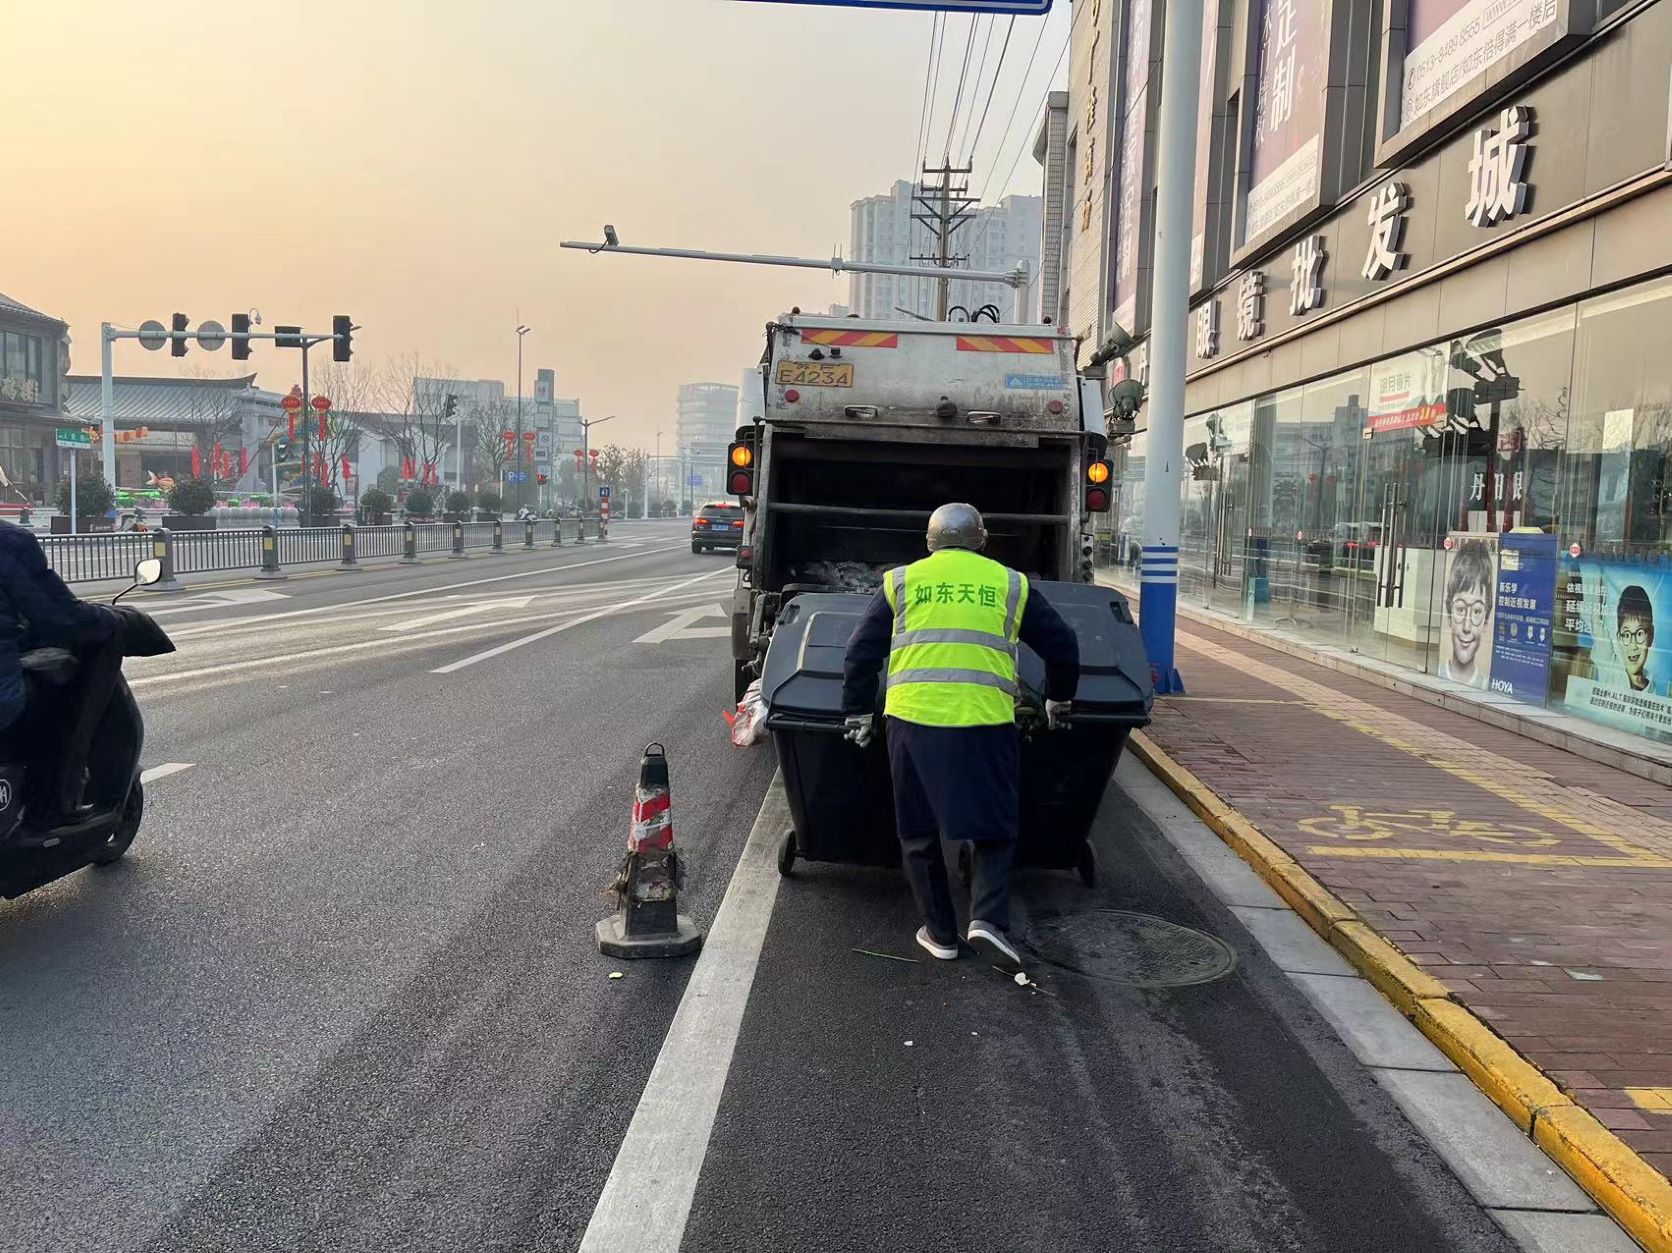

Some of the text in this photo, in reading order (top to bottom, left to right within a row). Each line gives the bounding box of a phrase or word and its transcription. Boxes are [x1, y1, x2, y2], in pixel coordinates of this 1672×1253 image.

[780, 369, 848, 385] E4234
[915, 582, 997, 608] 如东天恒
[1491, 678, 1513, 694] HOYA
